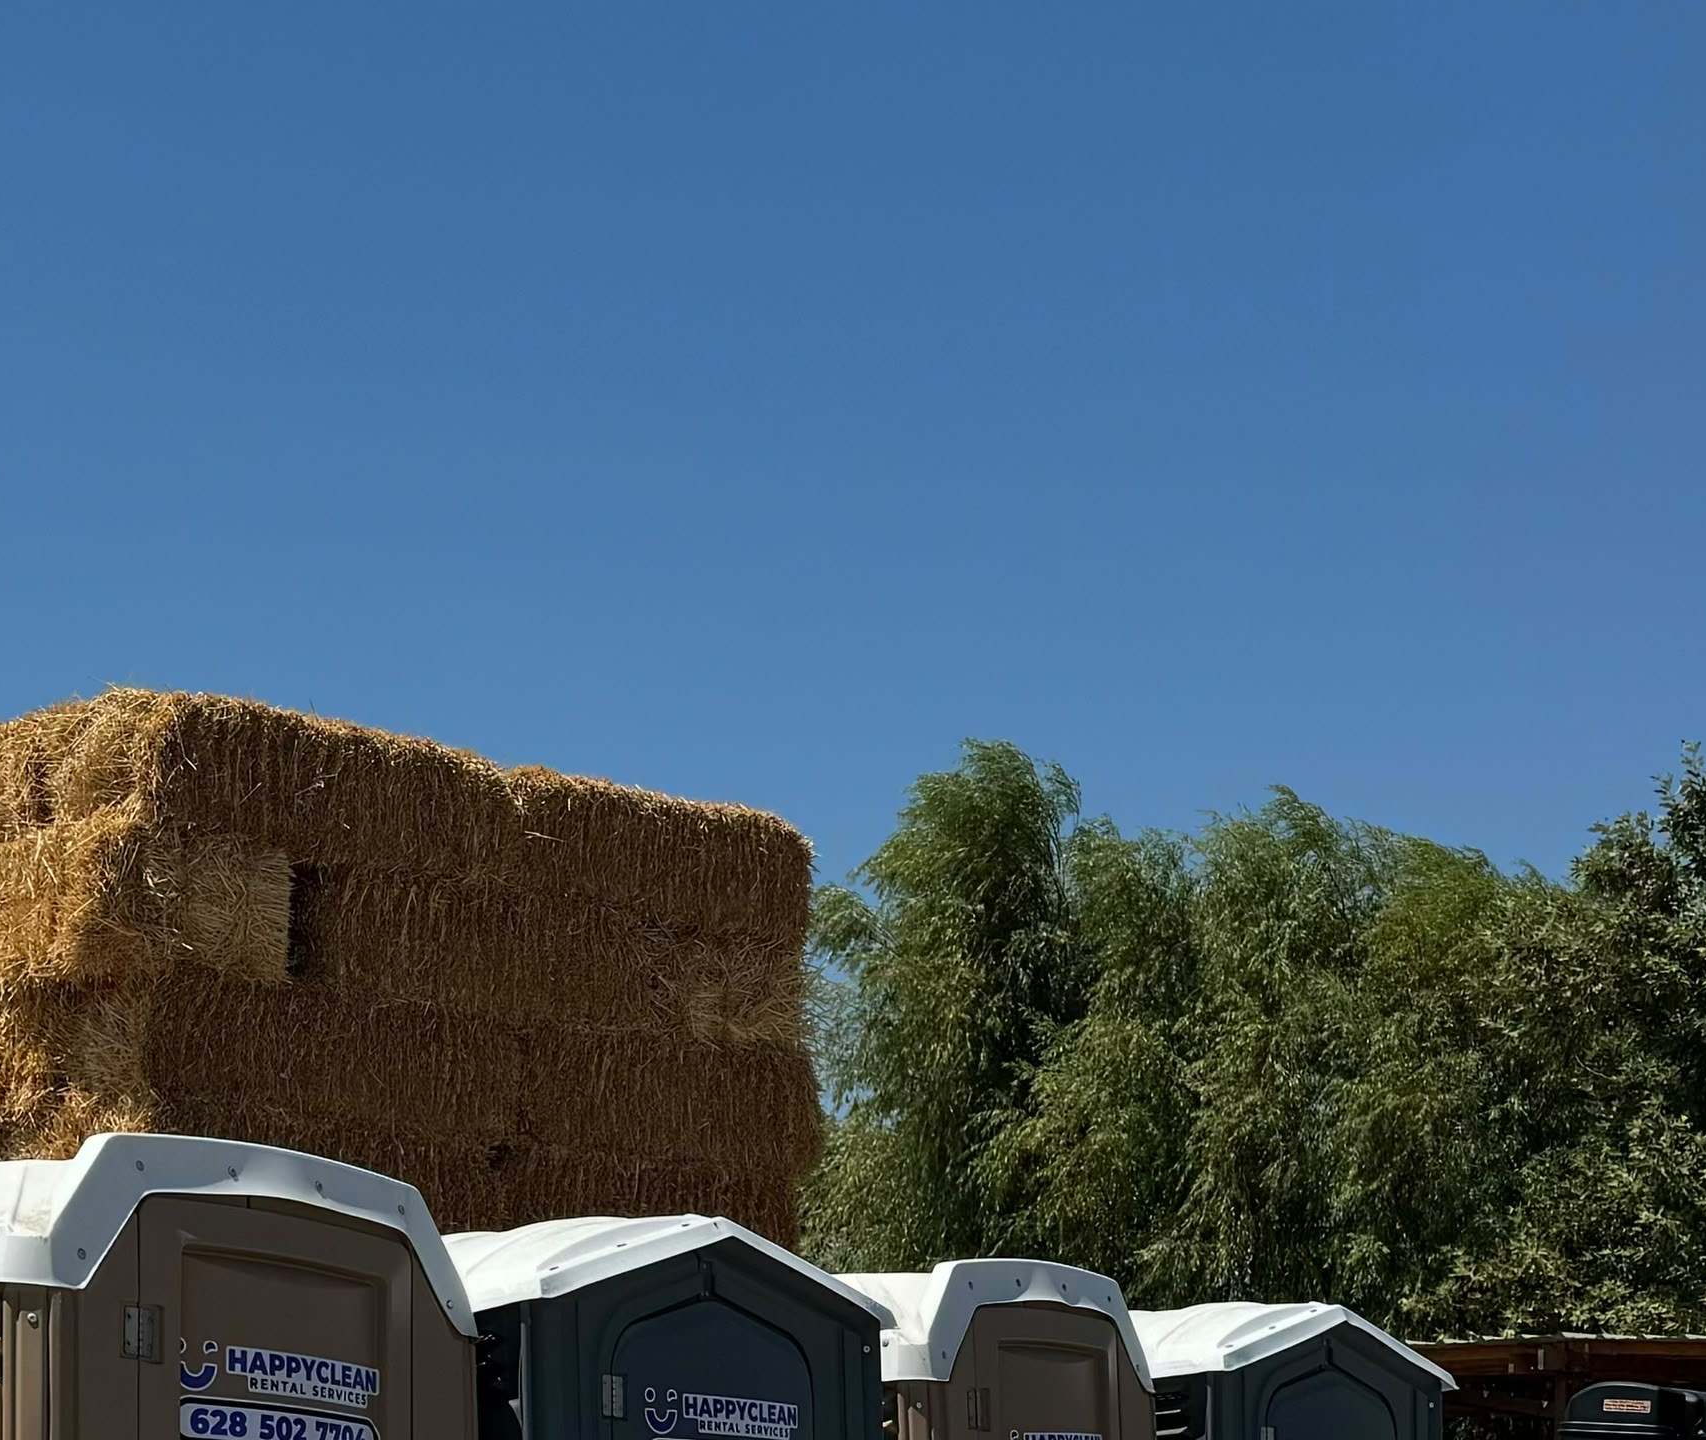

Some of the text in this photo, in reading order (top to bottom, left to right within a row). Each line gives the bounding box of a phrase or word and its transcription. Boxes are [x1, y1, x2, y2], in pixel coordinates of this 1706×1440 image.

[228, 1348, 377, 1393] HAPPYCLEAN
[249, 1376, 367, 1406] RENTAL SERVICES
[190, 1408, 247, 1438] 628
[684, 1395, 797, 1427] HAPPYCLEAN
[699, 1420, 789, 1439] RENTAL SERVICES
